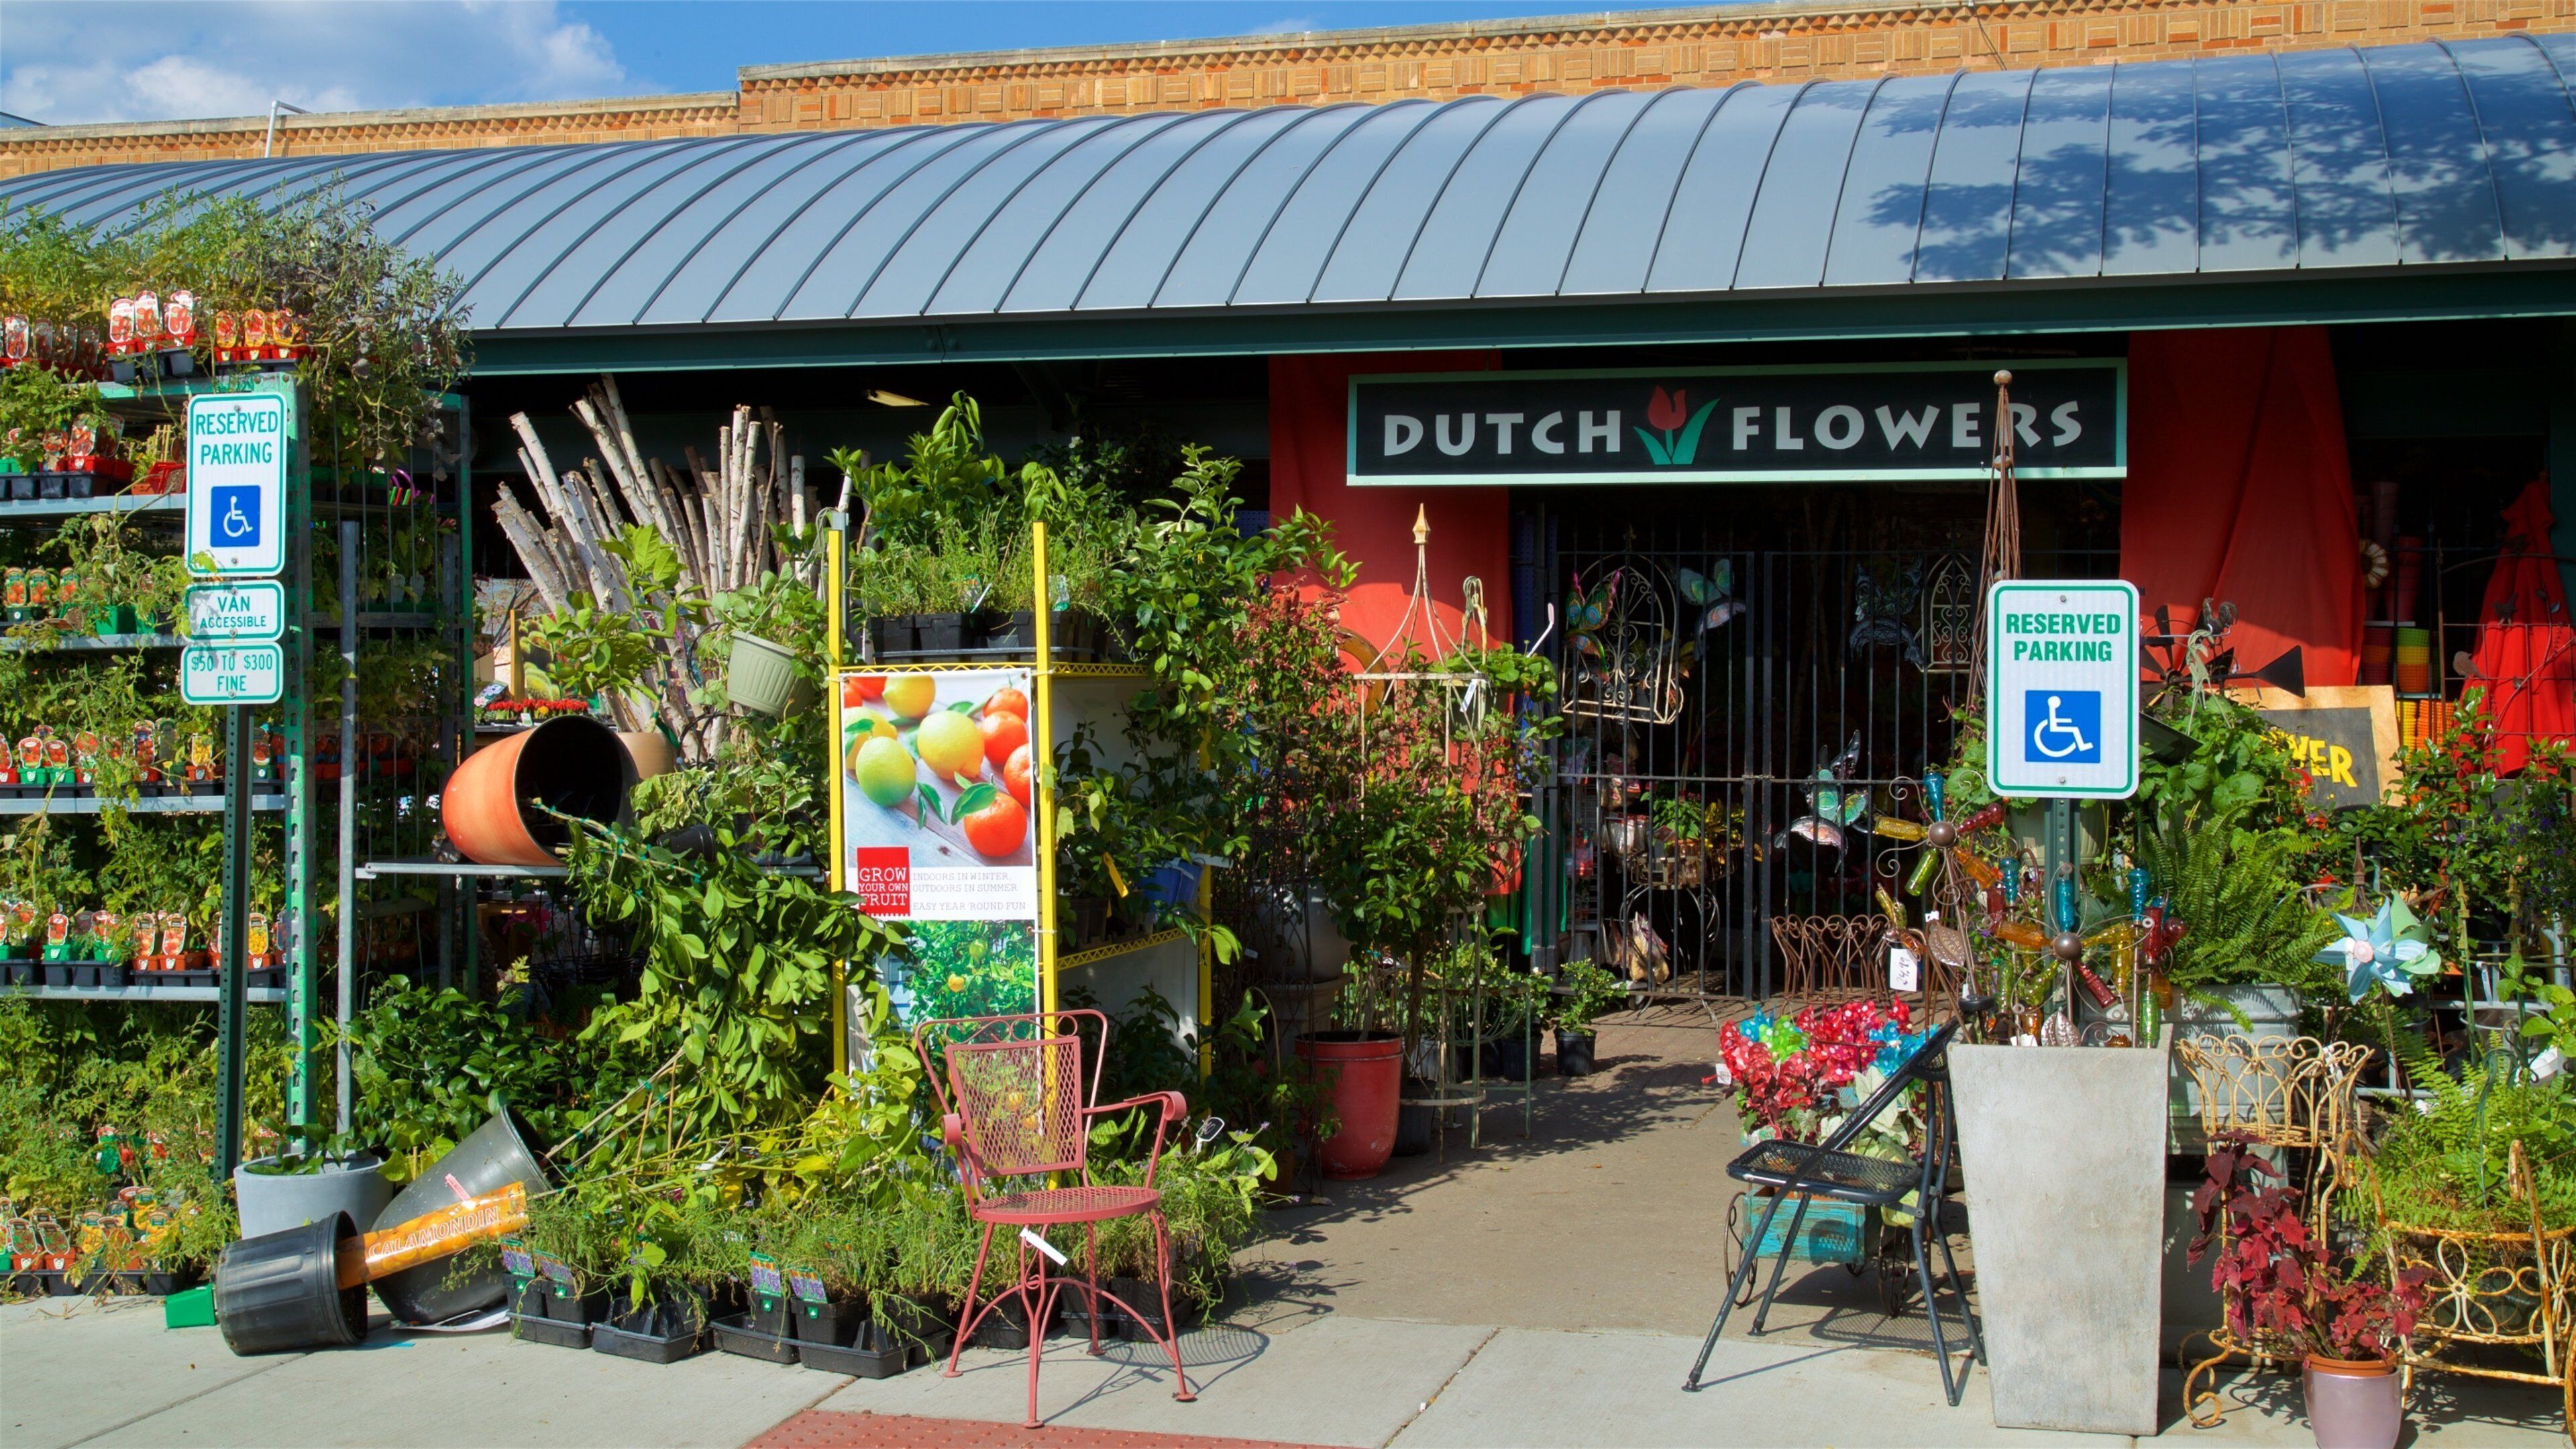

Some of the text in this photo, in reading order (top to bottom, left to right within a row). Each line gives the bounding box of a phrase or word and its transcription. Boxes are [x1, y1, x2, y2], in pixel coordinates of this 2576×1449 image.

[195, 411, 278, 435] RESERVED
[1384, 400, 2082, 456] DUTCH FLOWERS
[201, 441, 272, 466] PARKING
[217, 596, 250, 612] VAN
[200, 615, 267, 629] ACCESSIBLE
[2006, 613, 2121, 635] RESERVED
[2014, 641, 2112, 662] PARKING
[191, 653, 272, 672] $50 TO $300
[217, 675, 247, 692] FINE
[859, 867, 907, 882] GROW
[913, 873, 955, 881] INDOORS
[957, 872, 968, 880] IN
[859, 883, 909, 892] YOUR OWN
[913, 883, 1018, 892] OUTDOORS IN SUMMER
[913, 902, 937, 910] EASY
[940, 902, 966, 910] YEAR
[368, 1205, 500, 1258] CALAMONDIN
